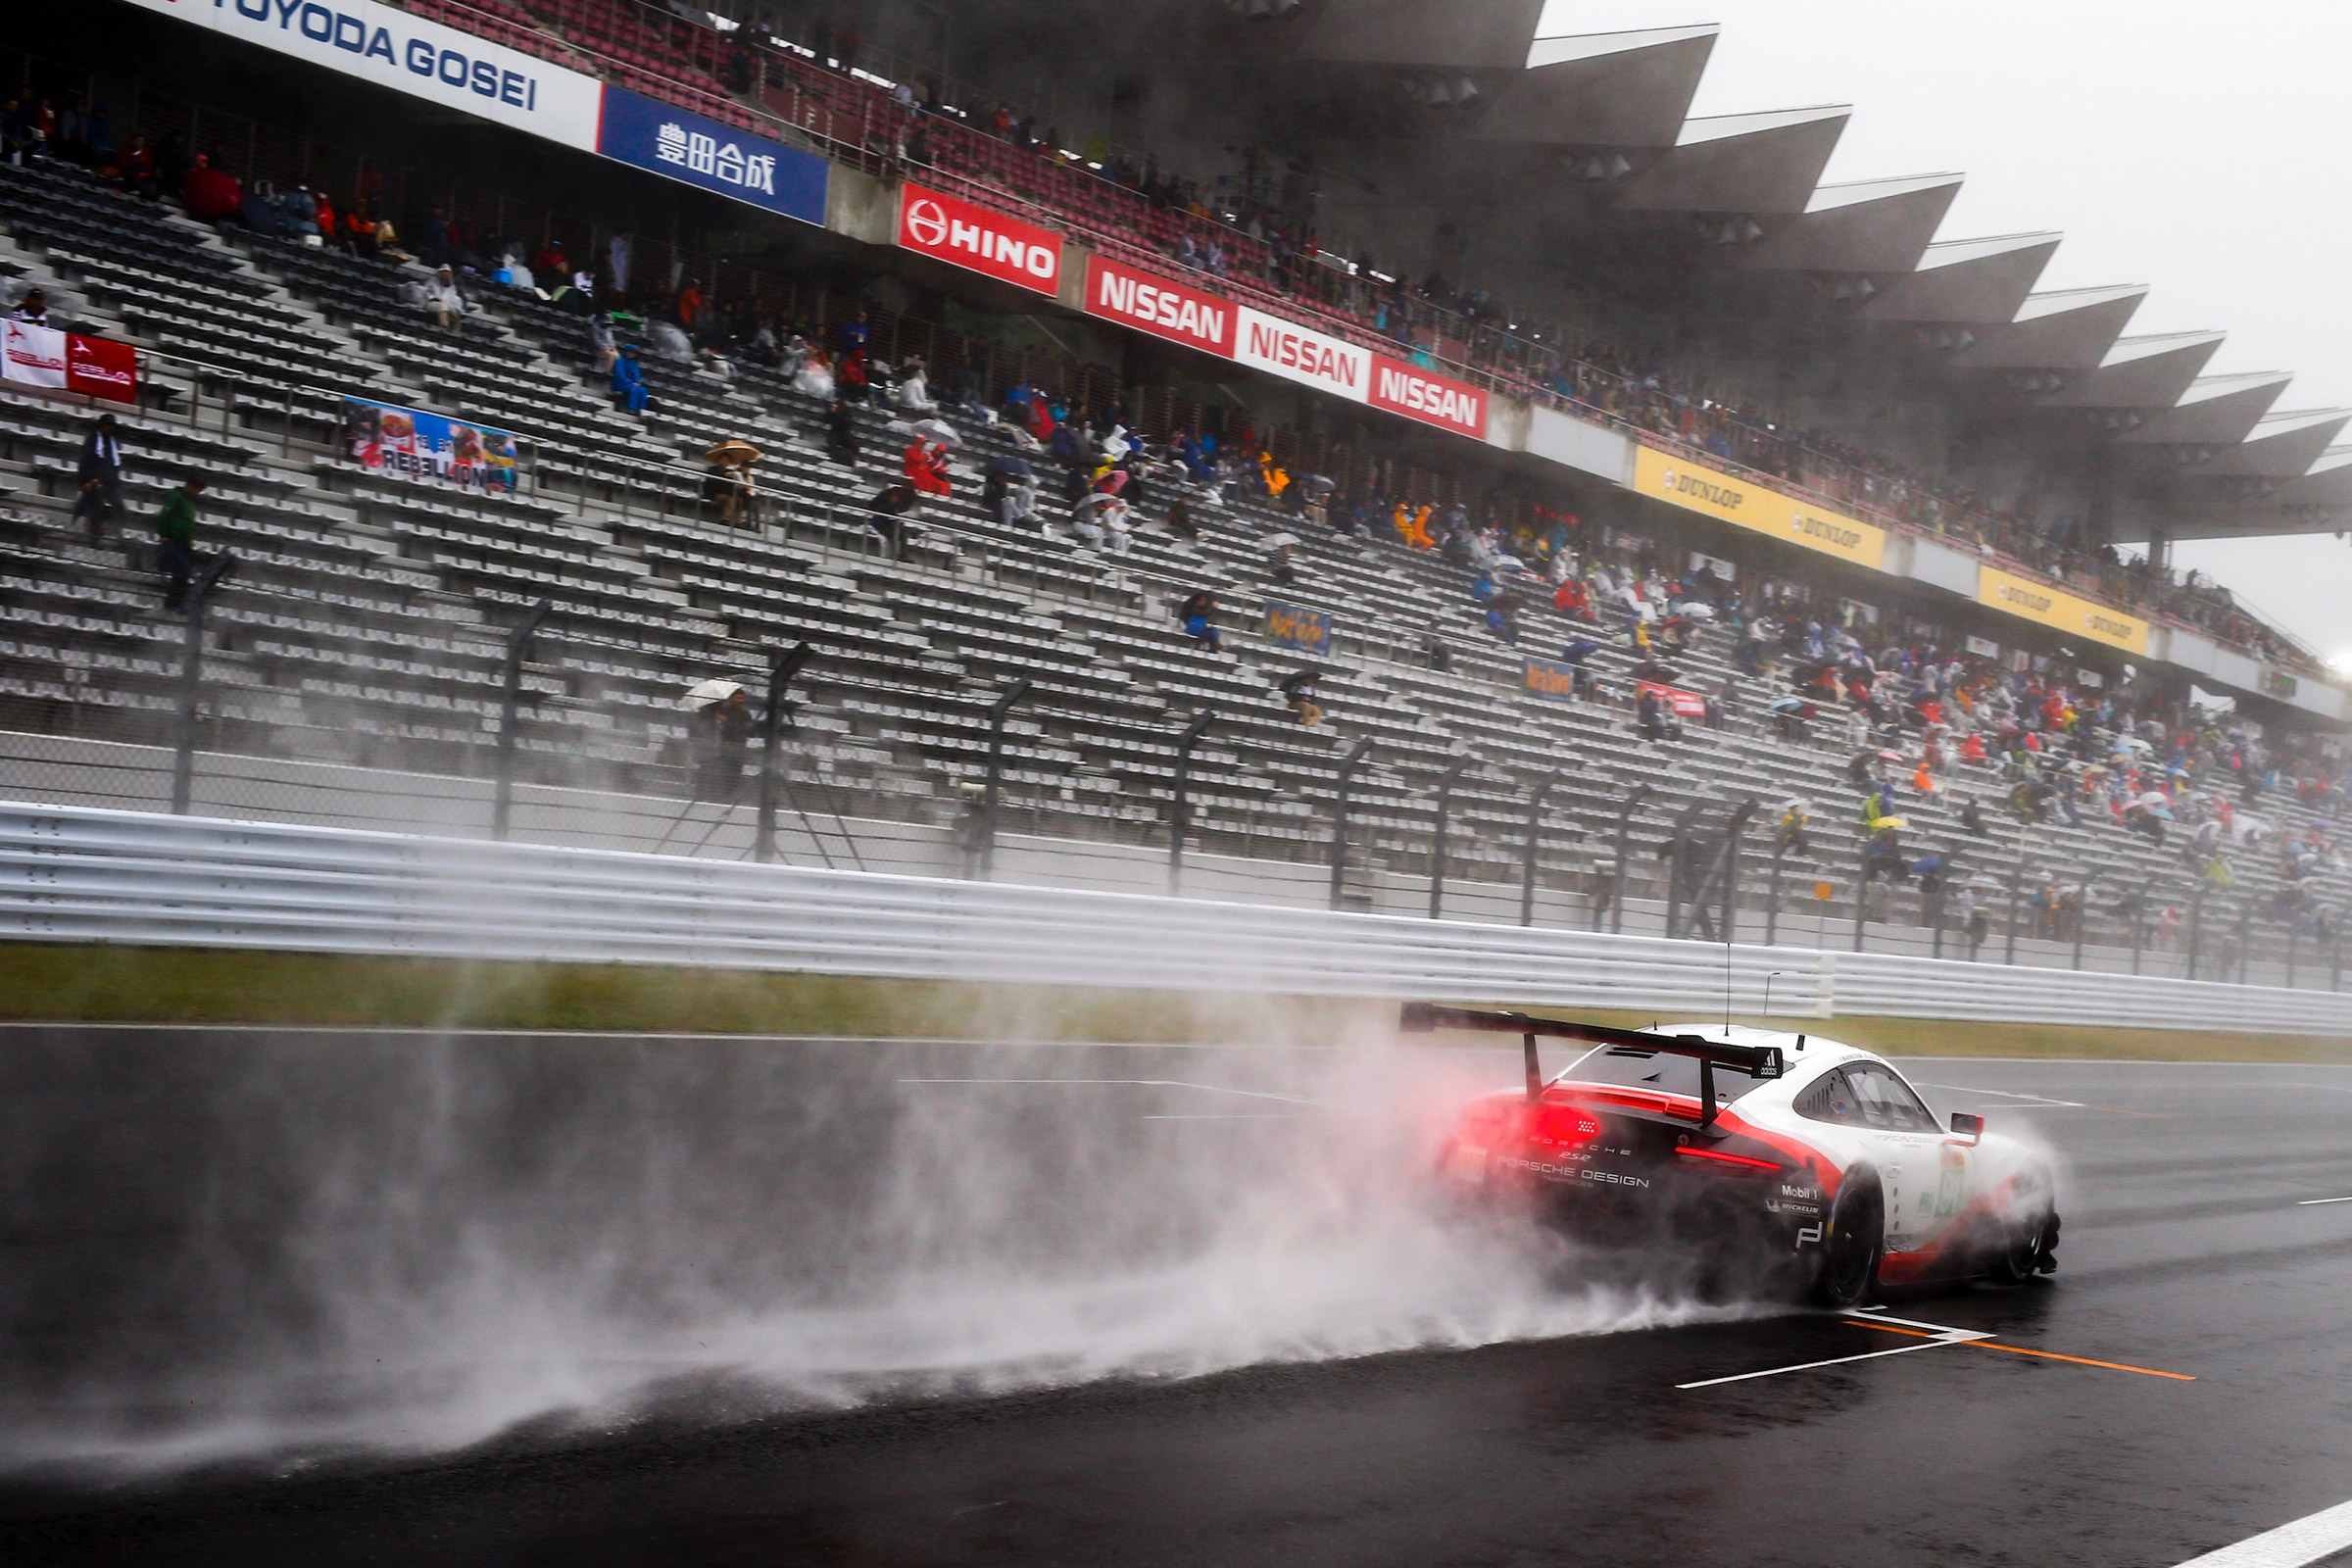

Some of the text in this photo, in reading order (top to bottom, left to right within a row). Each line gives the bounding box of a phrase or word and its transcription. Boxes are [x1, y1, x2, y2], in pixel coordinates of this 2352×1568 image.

[213, 0, 537, 112] OYODA GOSEI
[656, 122, 777, 196] 豊田合成
[950, 219, 1055, 278] HINO
[1100, 270, 1224, 344] NISSAN
[1250, 321, 1357, 387] NISSAN
[1379, 367, 1478, 427] NISSAN
[381, 449, 489, 488] REBELLION
[1676, 474, 1743, 510] DUNLOP
[1803, 517, 1861, 549] DUNLOP
[1528, 1135, 1632, 1156] PORSCHE
[1558, 1151, 1592, 1162] RSR
[1496, 1155, 1576, 1177] PORSCHE
[1581, 1168, 1650, 1189] DESIGN
[1782, 1184, 1810, 1200] Mobil
[1782, 1202, 1819, 1214] MICHELIN
